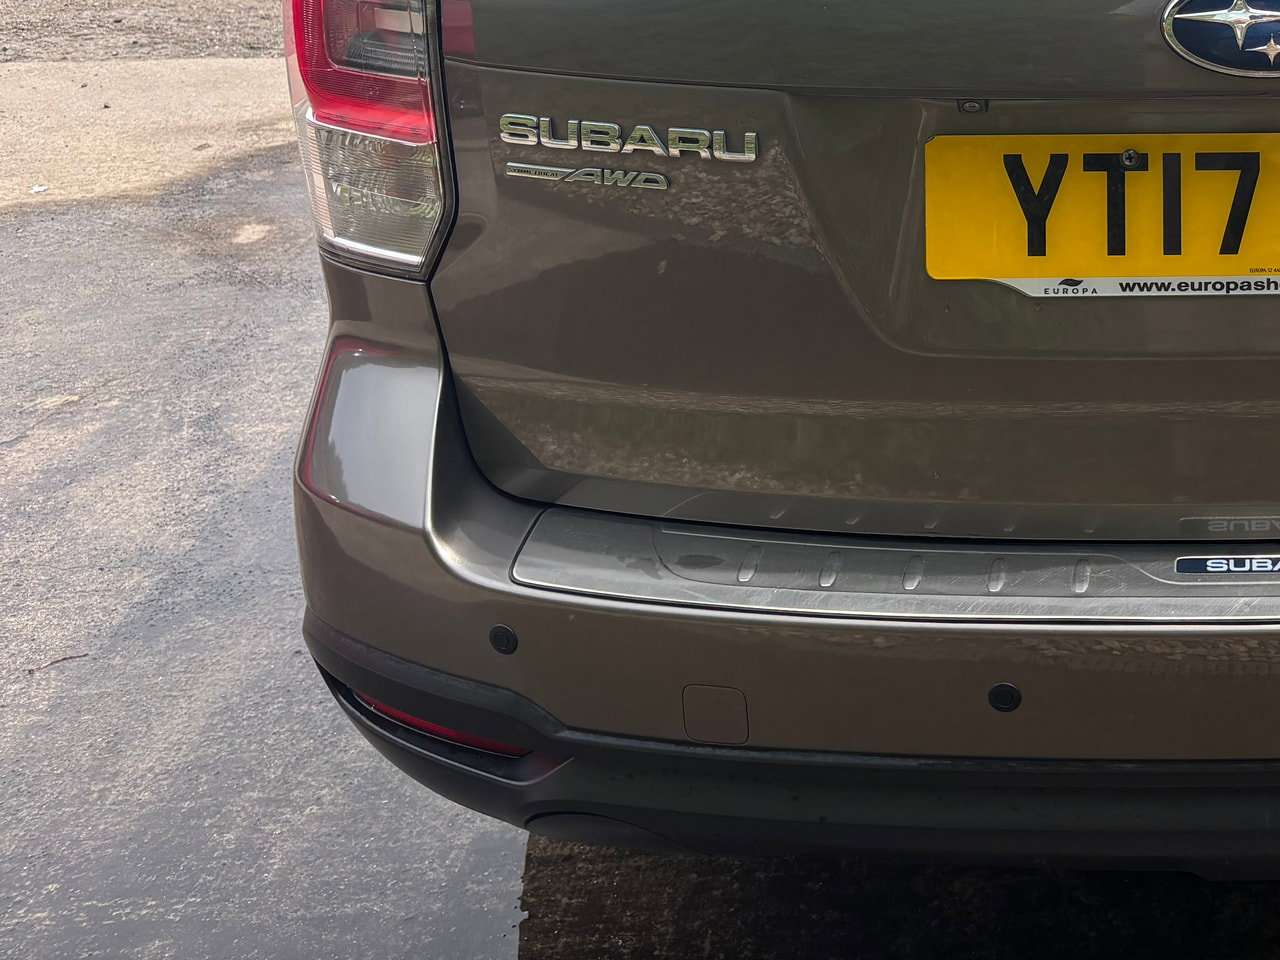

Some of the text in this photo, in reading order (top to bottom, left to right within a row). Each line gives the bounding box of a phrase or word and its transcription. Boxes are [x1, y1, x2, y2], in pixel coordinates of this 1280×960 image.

[500, 113, 758, 161] SUBARU
[564, 167, 669, 189] AWD
[1003, 151, 1260, 257] YT17
[1043, 287, 1098, 295] EUROPA
